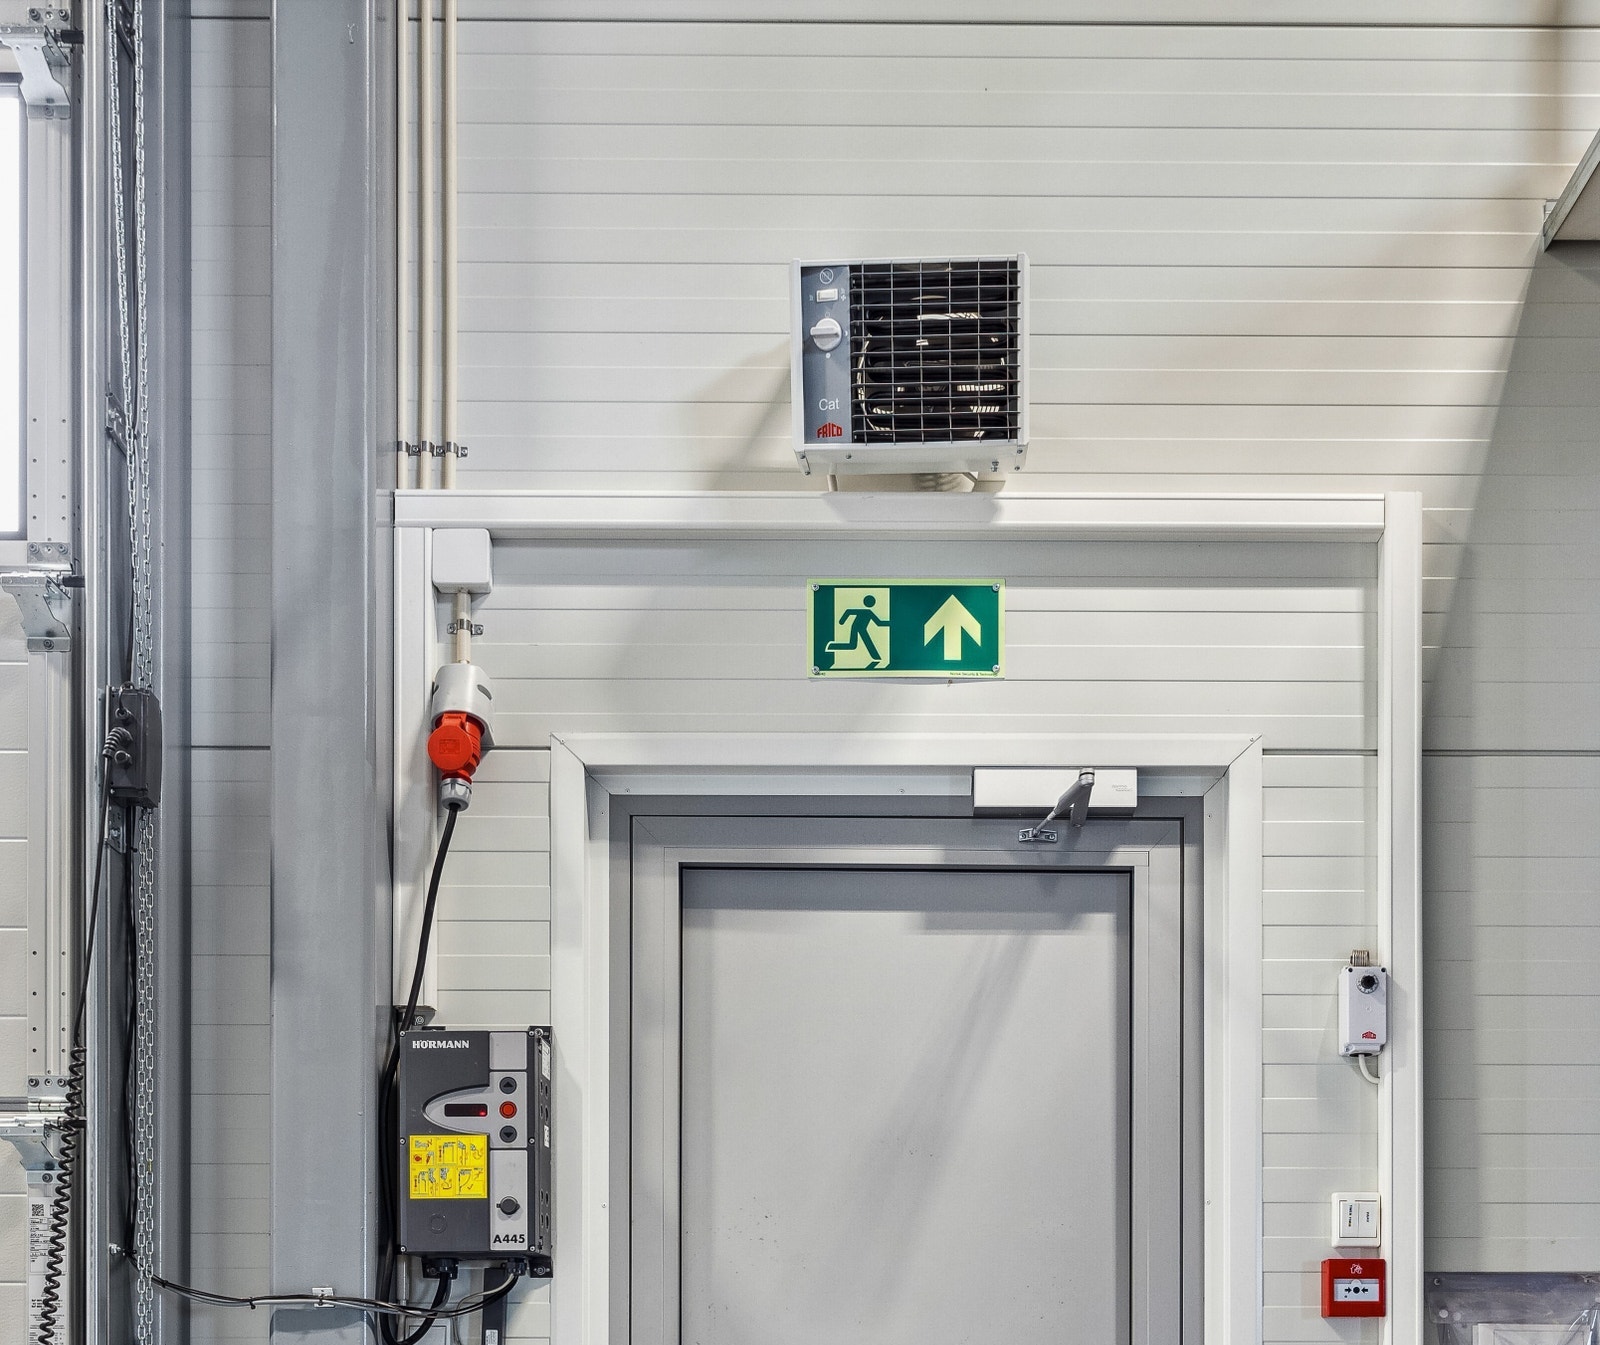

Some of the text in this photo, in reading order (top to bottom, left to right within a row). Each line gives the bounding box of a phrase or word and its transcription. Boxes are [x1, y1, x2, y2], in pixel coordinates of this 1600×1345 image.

[818, 398, 840, 411] Cat
[816, 422, 843, 439] FRICO
[412, 1039, 470, 1049] HÖRMANN
[493, 1234, 525, 1244] A445
